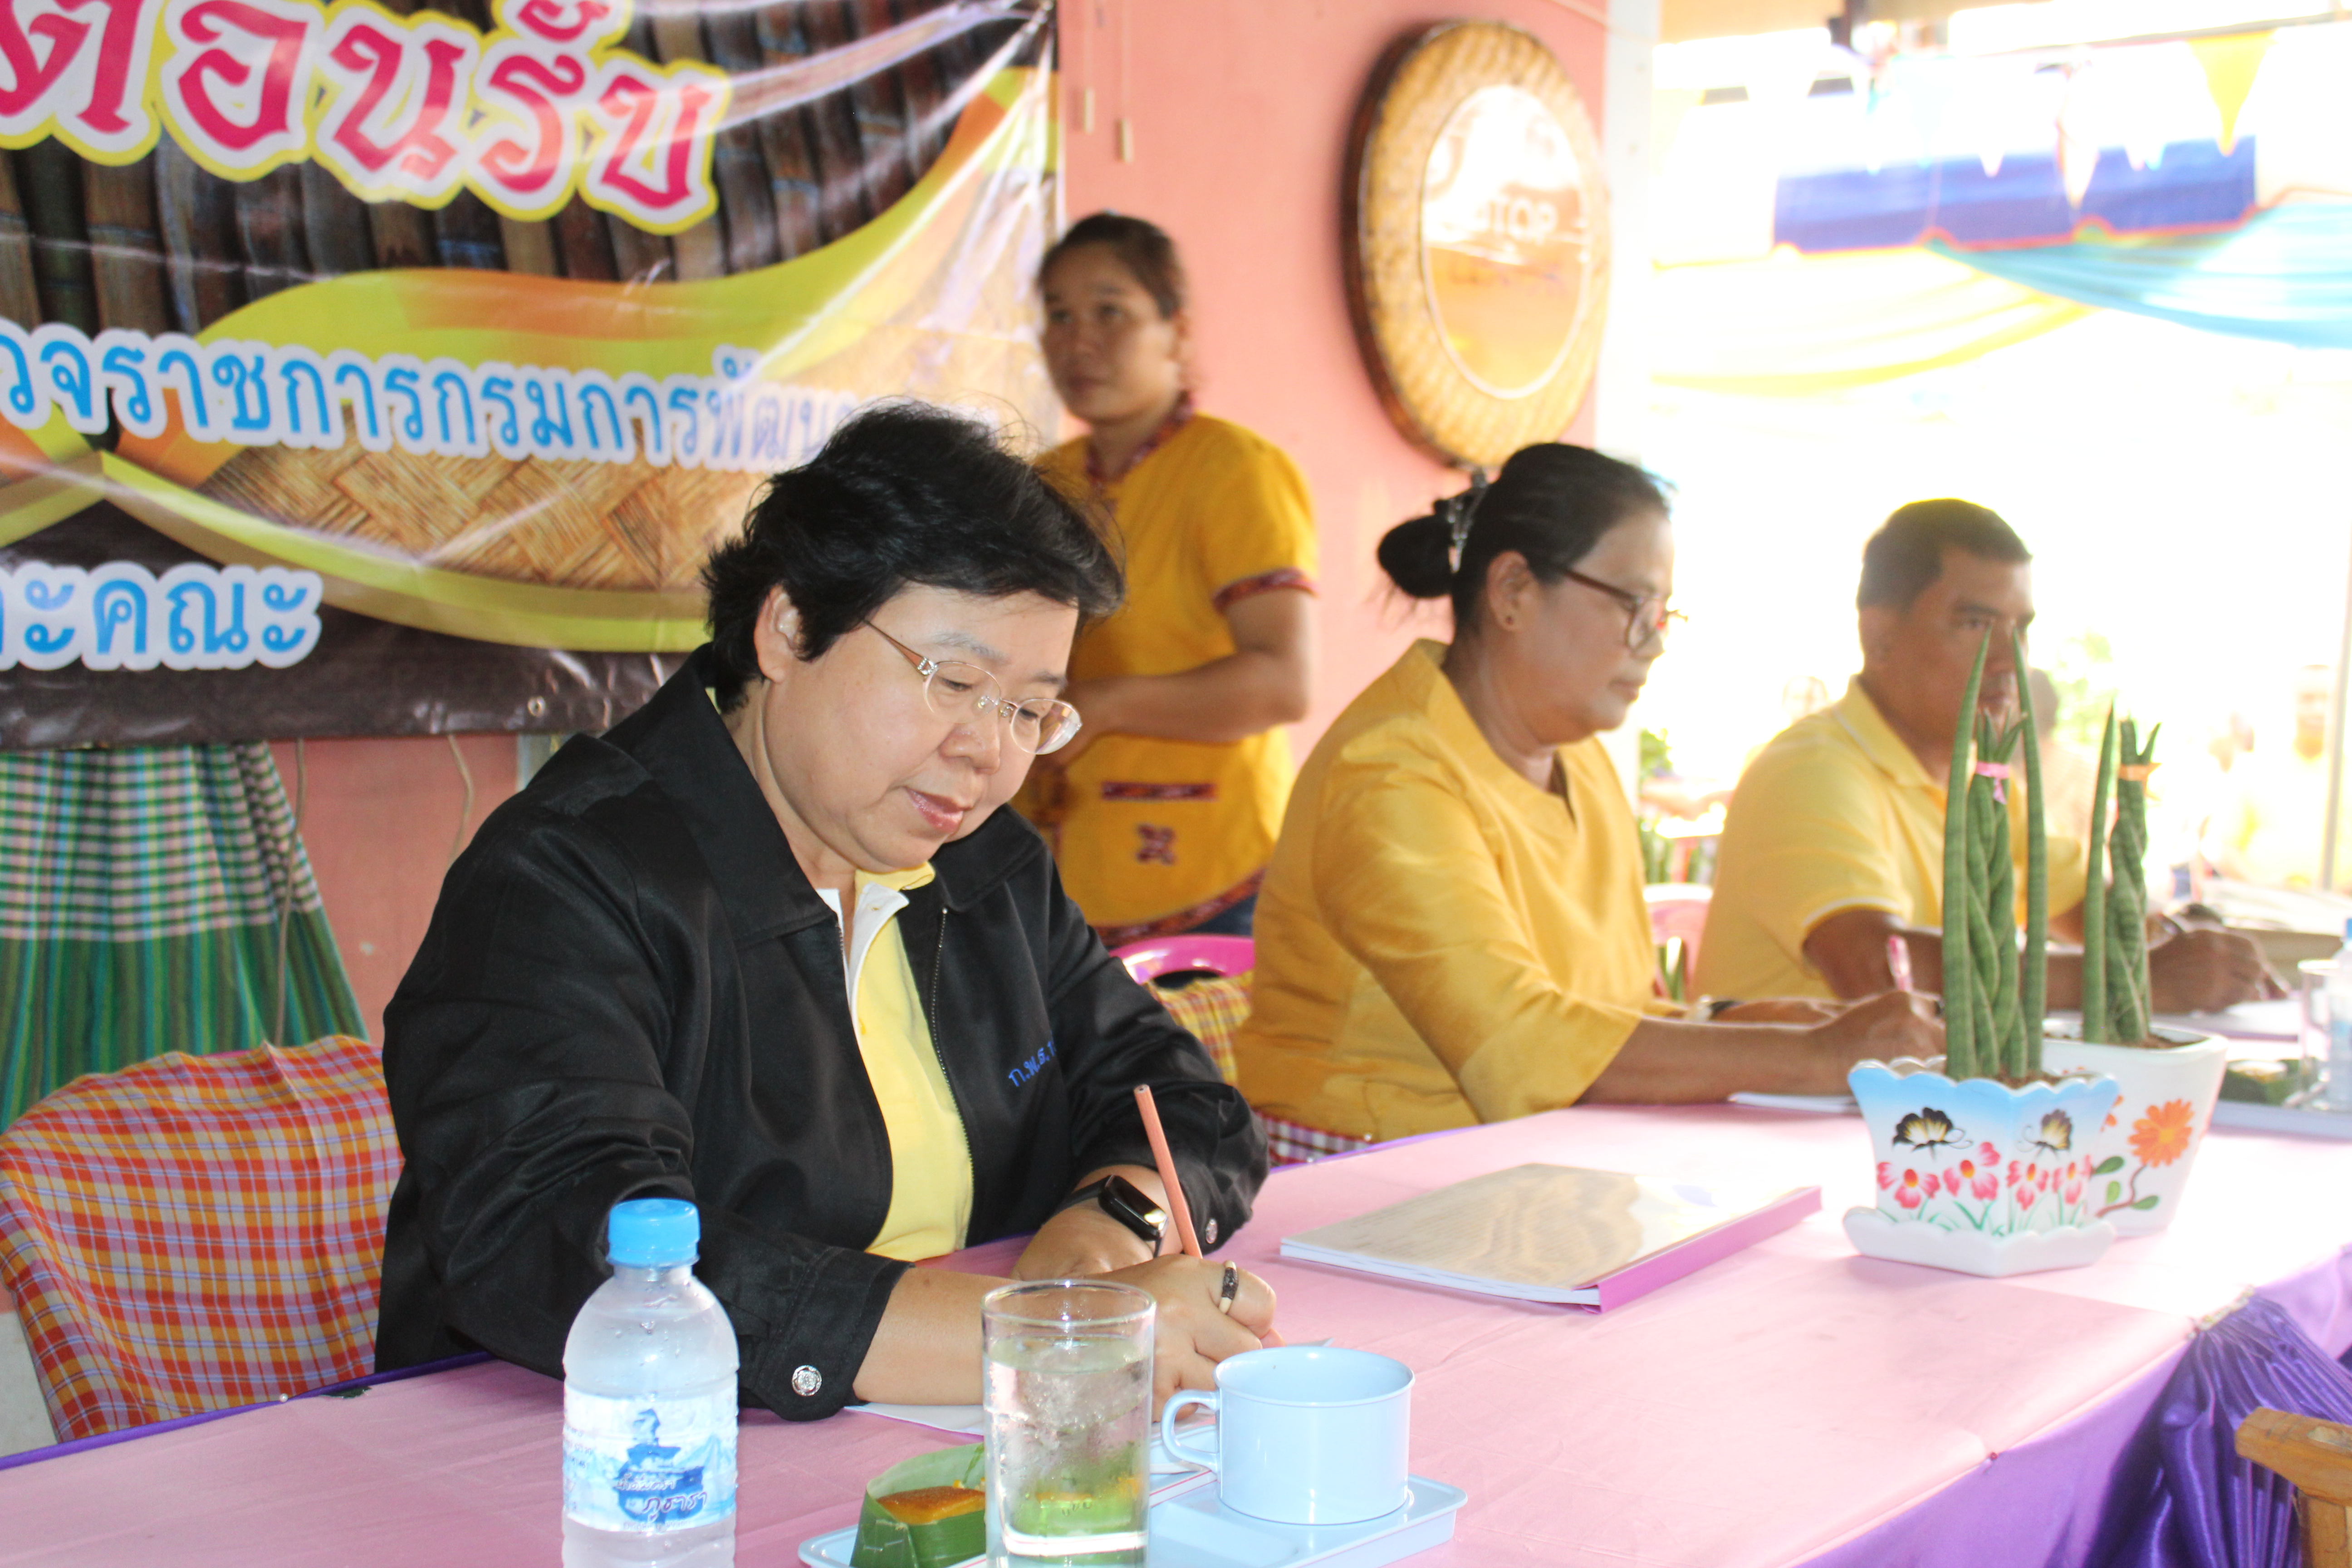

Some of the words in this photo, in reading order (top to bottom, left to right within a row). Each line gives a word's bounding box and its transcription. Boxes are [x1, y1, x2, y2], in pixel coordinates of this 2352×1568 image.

[0, 0, 711, 210] ตอนรับ
[0, 334, 852, 460] วจราชการกรมการพัฒน
[0, 579, 307, 655] ะคณะ
